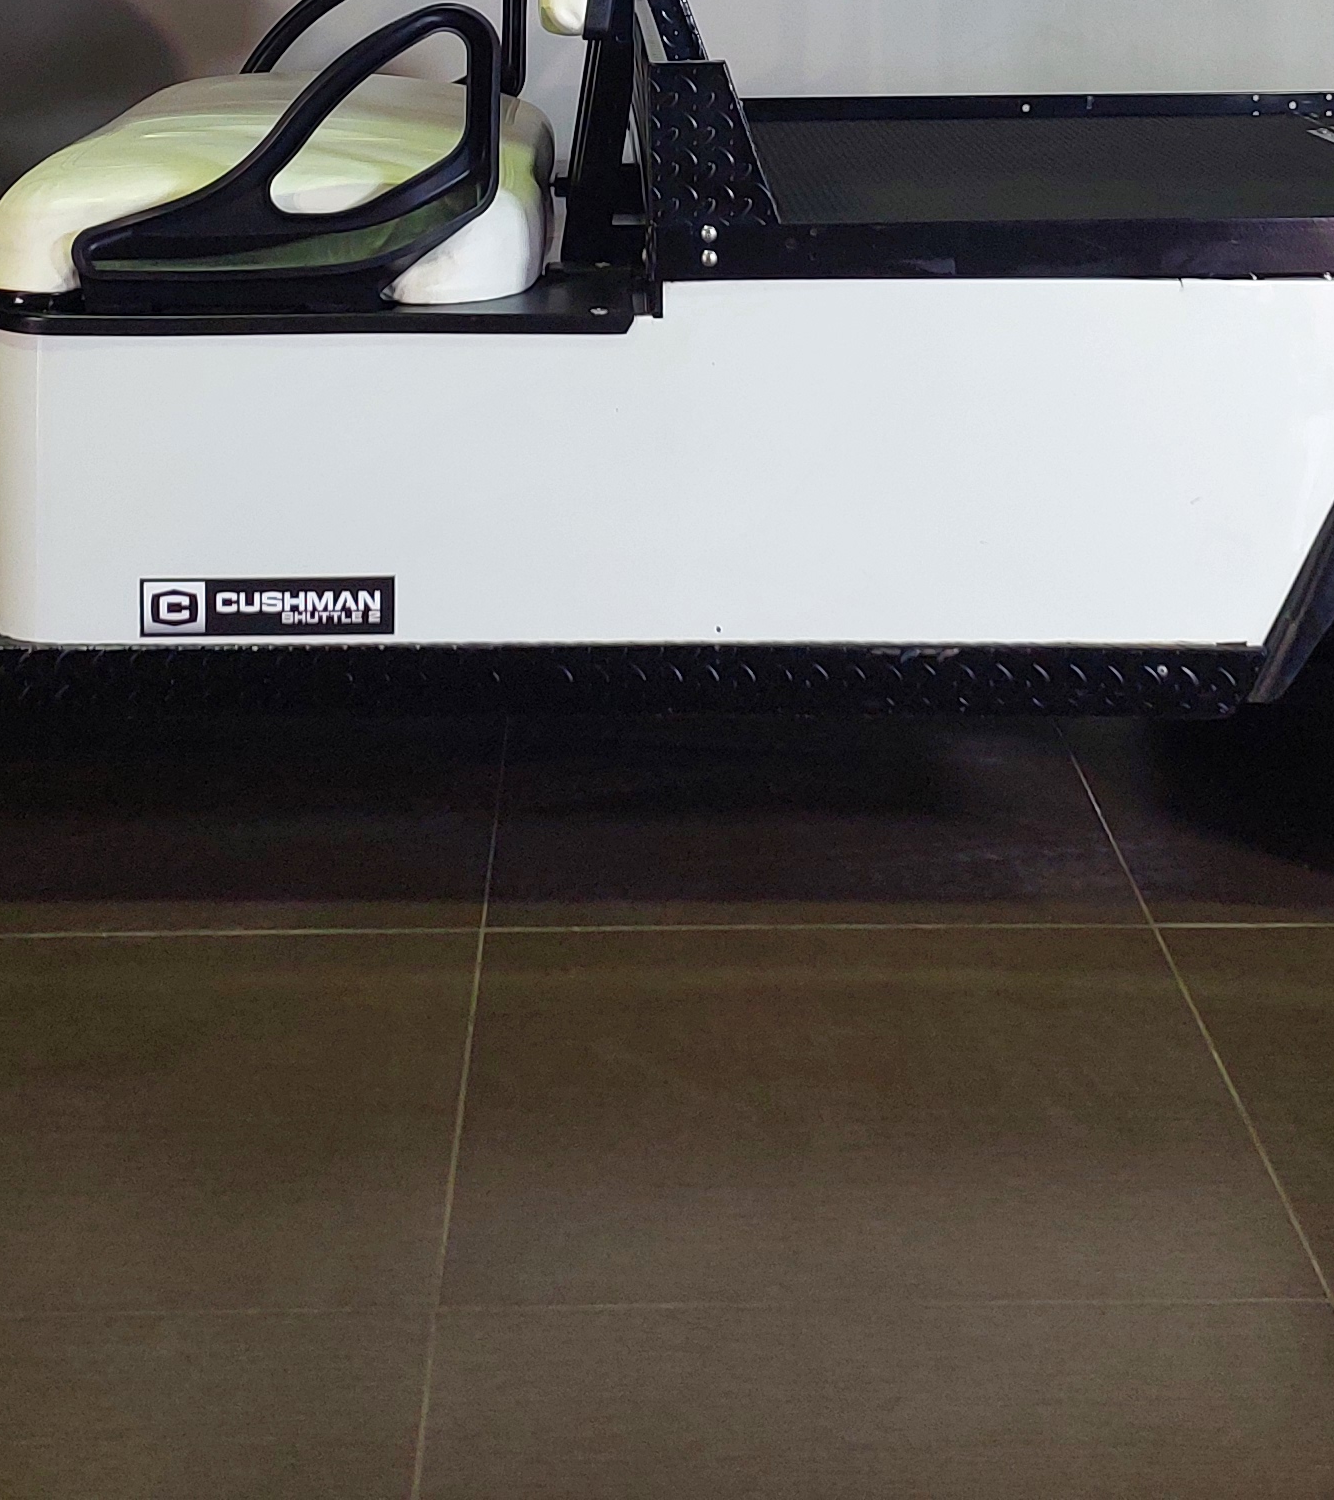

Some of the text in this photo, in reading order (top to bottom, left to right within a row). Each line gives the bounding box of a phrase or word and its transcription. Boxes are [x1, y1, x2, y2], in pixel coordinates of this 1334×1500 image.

[216, 589, 381, 614] CUSHMAN
[281, 610, 381, 626] SHUTTLE 2
